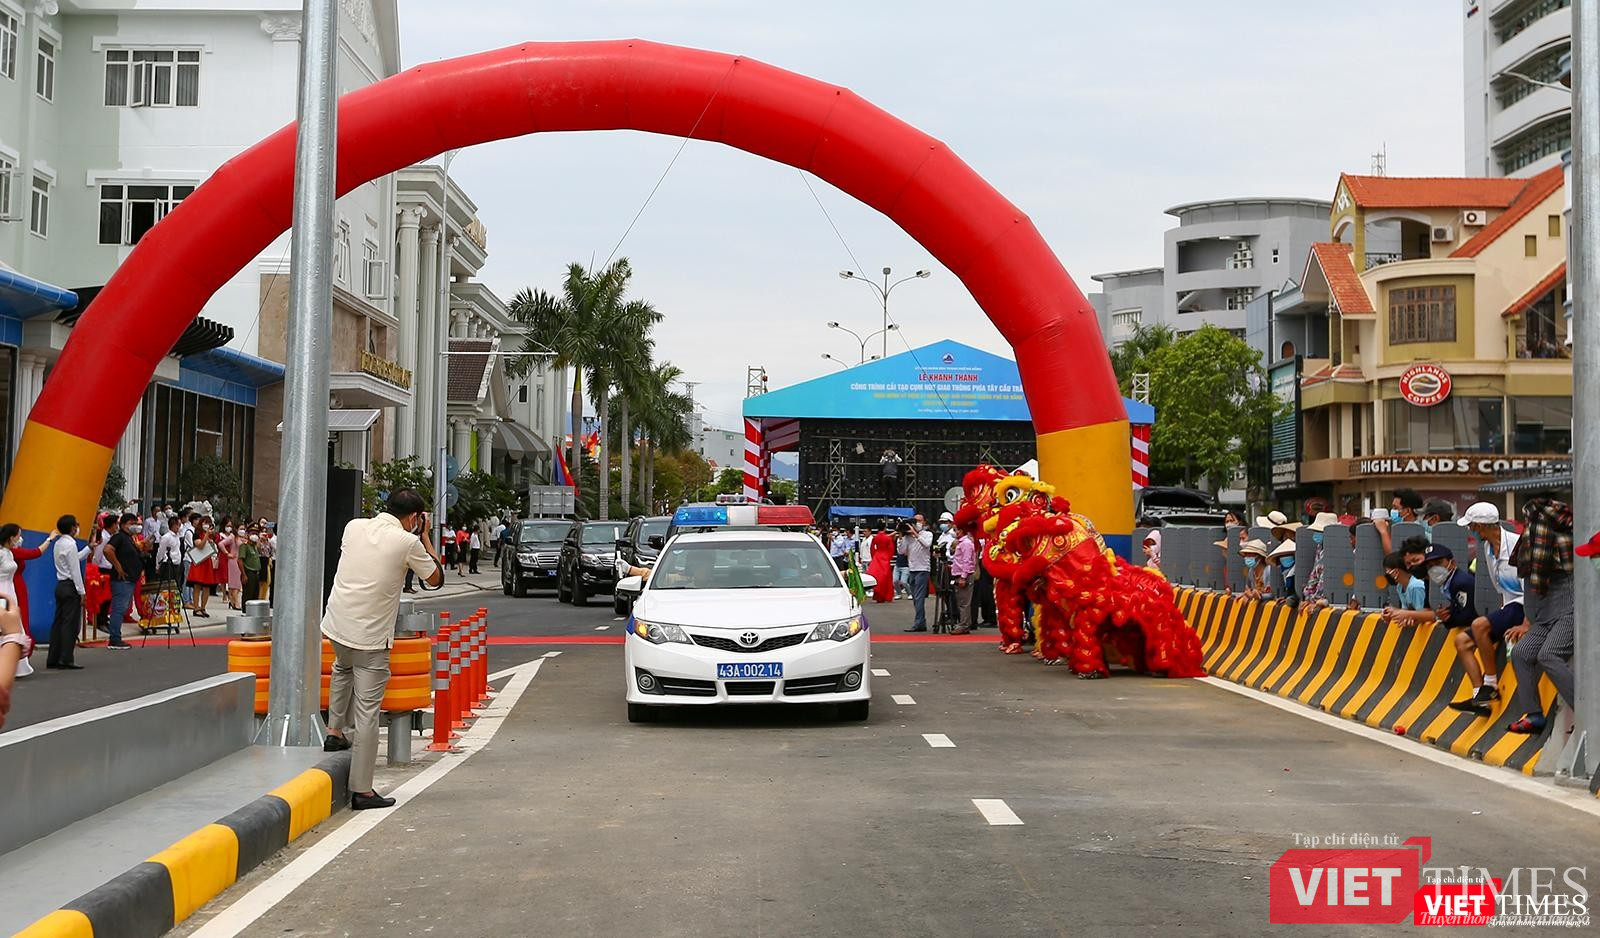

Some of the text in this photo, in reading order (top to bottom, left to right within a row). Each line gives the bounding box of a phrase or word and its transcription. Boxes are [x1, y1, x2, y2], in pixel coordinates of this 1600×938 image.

[1402, 366, 1448, 384] HIGHLANDS
[1407, 393, 1443, 404] COFFEE
[1360, 458, 1470, 473] HIGHLANDS
[719, 664, 782, 677] 43A-002.14
